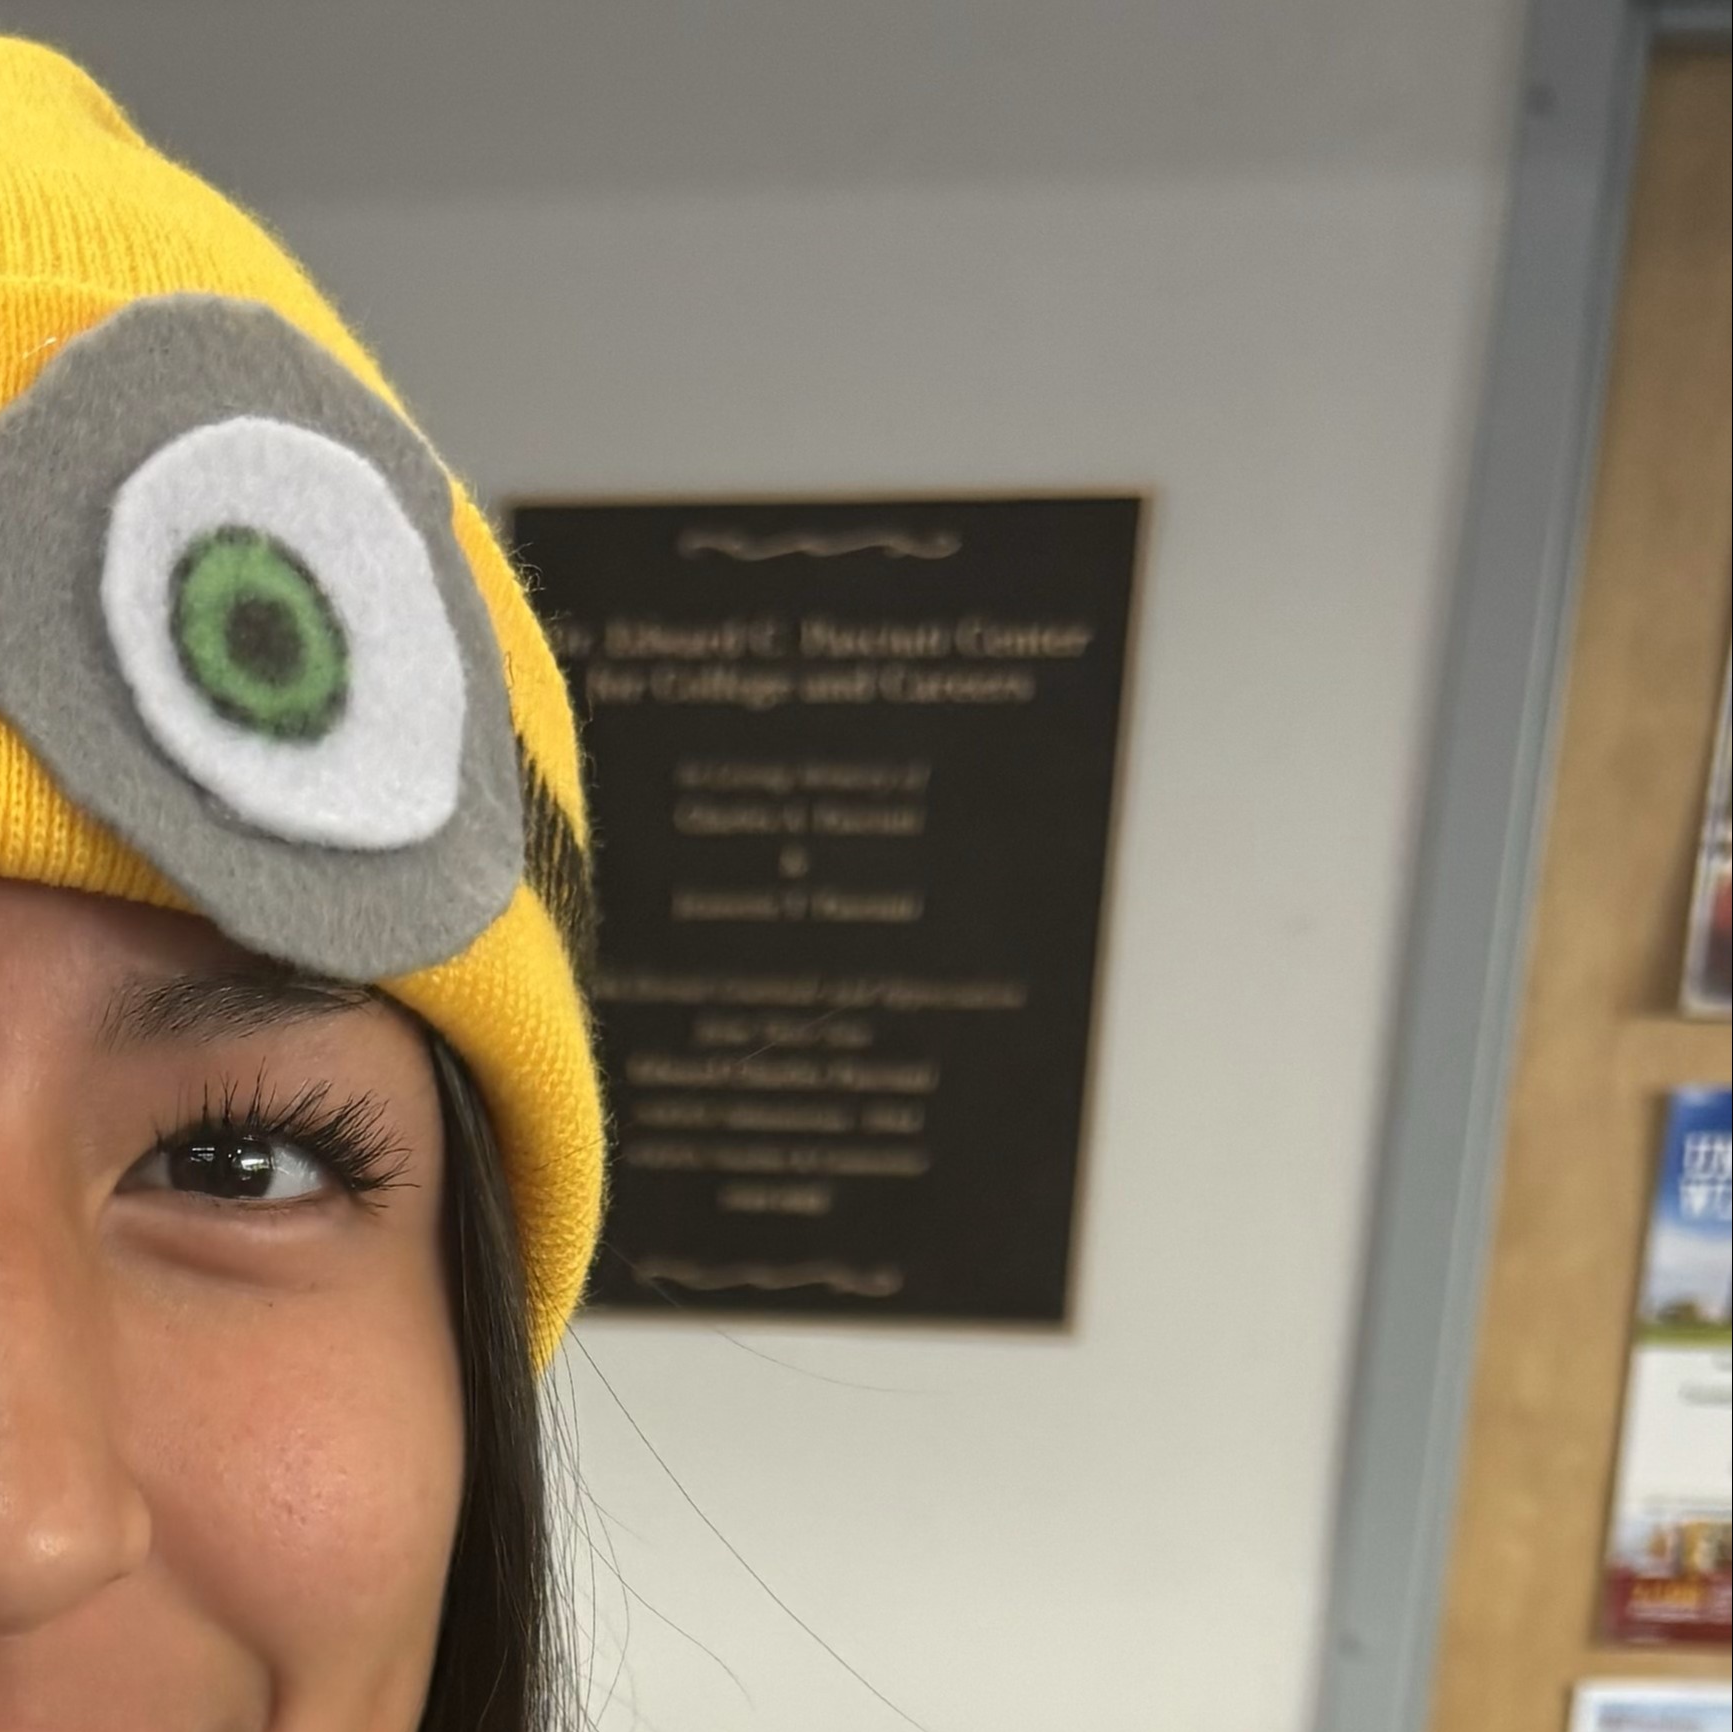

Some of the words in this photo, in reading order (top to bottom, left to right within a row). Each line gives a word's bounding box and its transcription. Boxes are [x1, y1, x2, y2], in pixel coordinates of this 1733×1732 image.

[604, 618, 743, 658] Edward
[956, 617, 1092, 658] Center
[586, 665, 645, 701] for
[649, 665, 793, 709] College
[798, 666, 874, 701] and
[879, 665, 1035, 701] Careers
